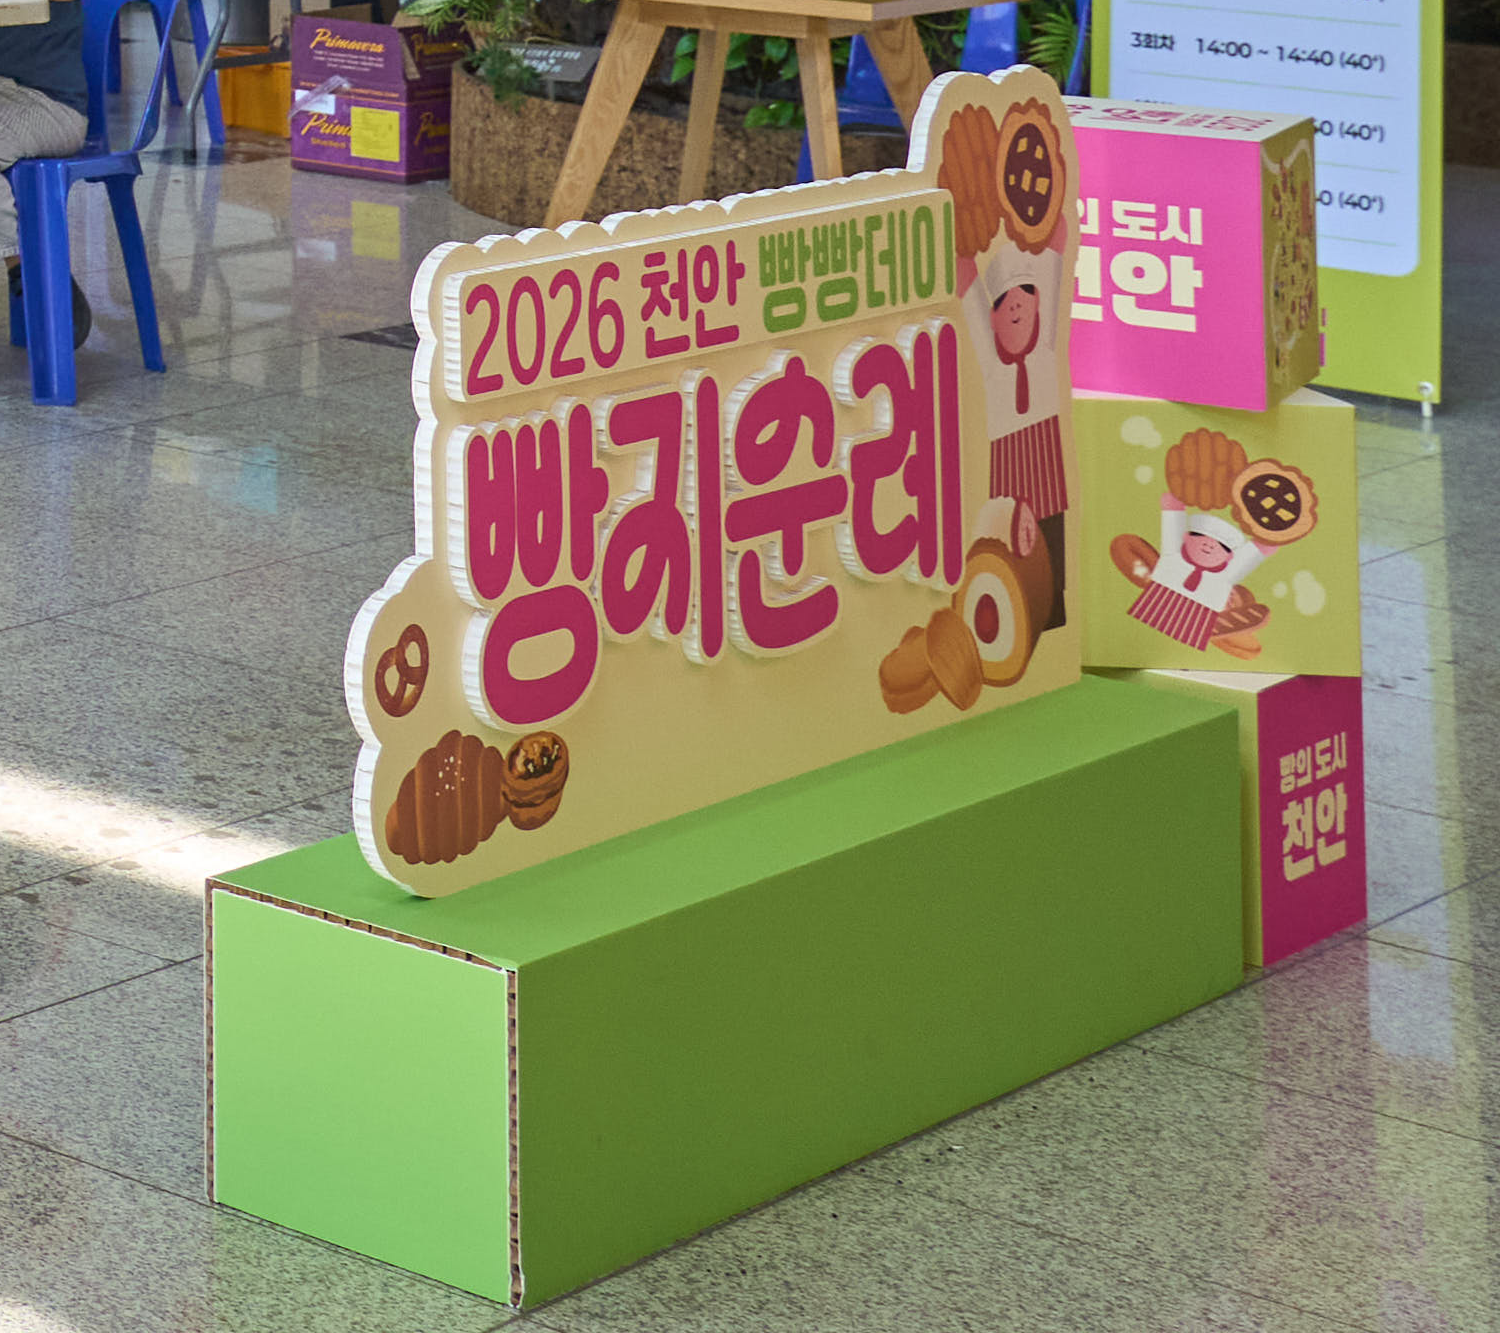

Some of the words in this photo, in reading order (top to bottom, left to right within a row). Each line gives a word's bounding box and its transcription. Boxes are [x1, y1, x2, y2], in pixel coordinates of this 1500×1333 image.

[310, 28, 386, 53] Primavera
[1130, 32, 1175, 51] 3회차
[1196, 37, 1253, 59] 14:00
[1276, 46, 1334, 67] 14:40
[1112, 200, 1203, 245] 도시
[465, 261, 625, 395] 2026
[641, 240, 745, 359] 천안
[758, 201, 955, 333] 빵빵데이
[467, 323, 962, 724] 빵지순례
[1280, 746, 1312, 794] 빵의
[1315, 732, 1347, 780] 도시
[1282, 782, 1348, 882] 천안
